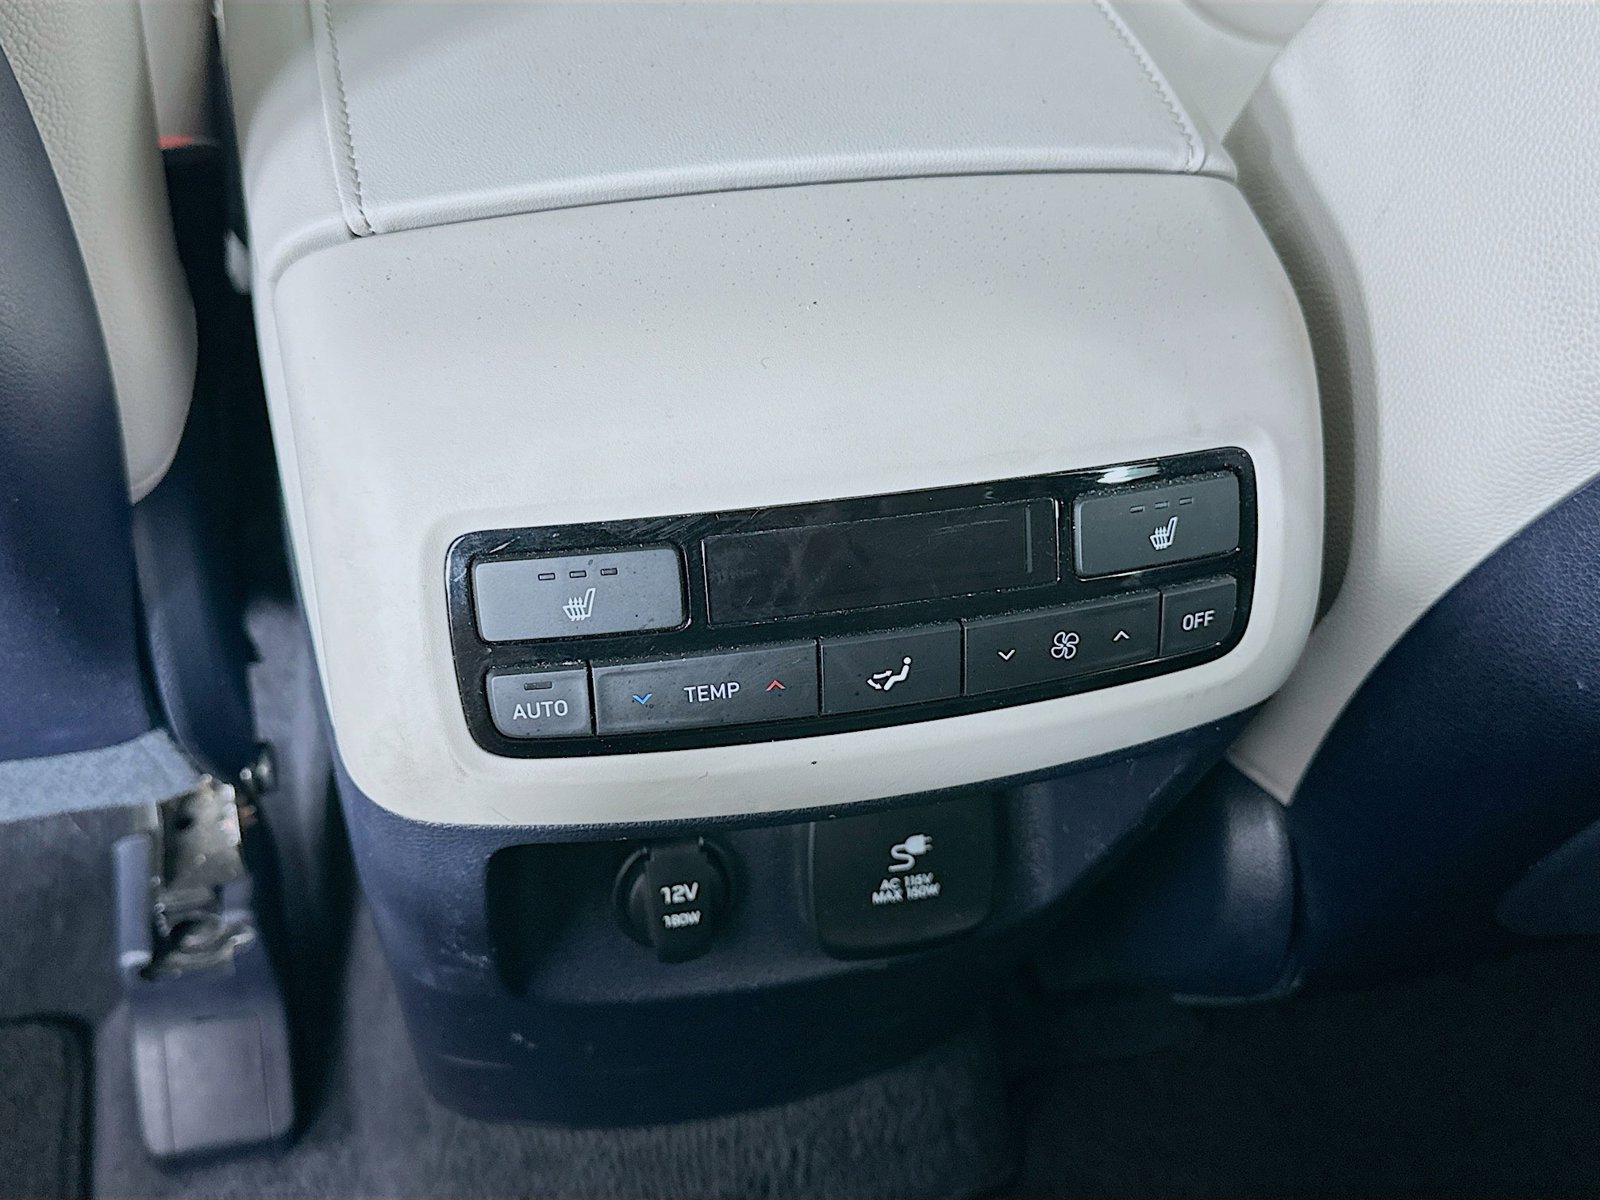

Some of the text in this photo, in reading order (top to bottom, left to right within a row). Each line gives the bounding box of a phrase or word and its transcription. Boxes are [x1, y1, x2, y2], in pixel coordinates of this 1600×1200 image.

[1182, 609, 1216, 631] OFF
[683, 681, 741, 703] TEMP
[512, 700, 569, 720] AUTO
[660, 881, 699, 905] 12V
[880, 877, 901, 891] AC
[872, 887, 904, 905] MAX
